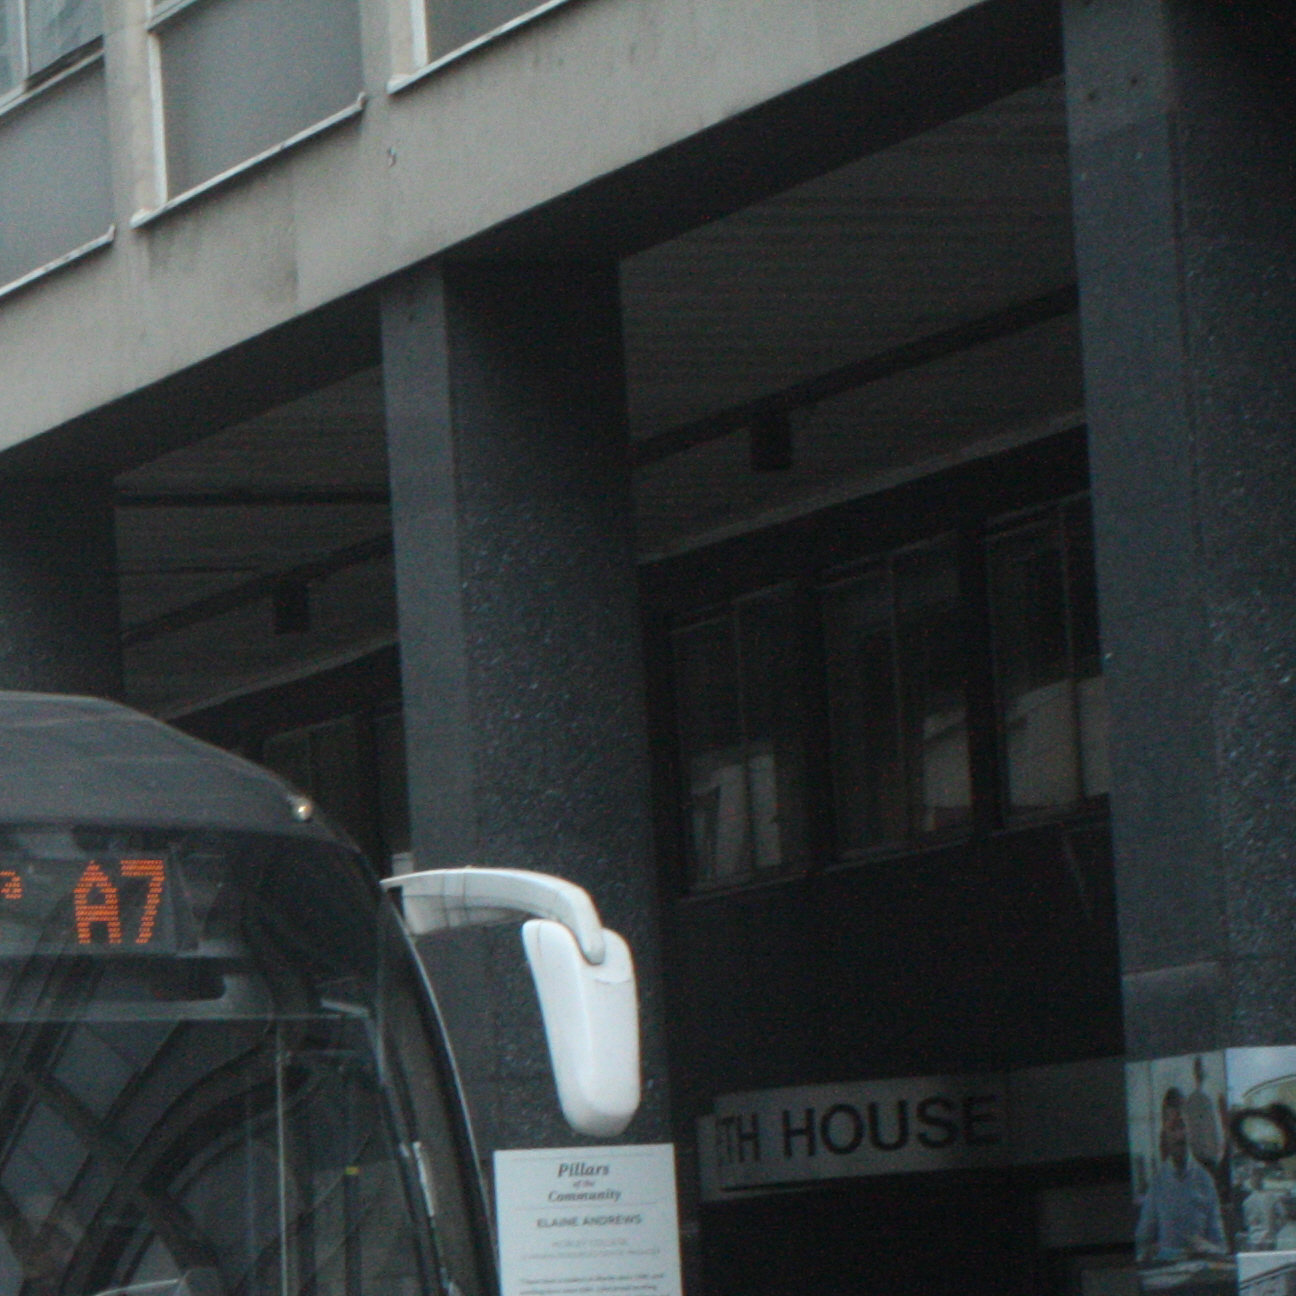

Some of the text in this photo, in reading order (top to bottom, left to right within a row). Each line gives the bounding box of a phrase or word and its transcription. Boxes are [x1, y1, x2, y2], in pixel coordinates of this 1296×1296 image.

[73, 859, 165, 944] A7
[782, 1093, 1002, 1158] HOUSE
[557, 1162, 610, 1178] Pillars
[547, 1190, 622, 1202] Community
[536, 1213, 643, 1229] ELAINE ANDREWS
